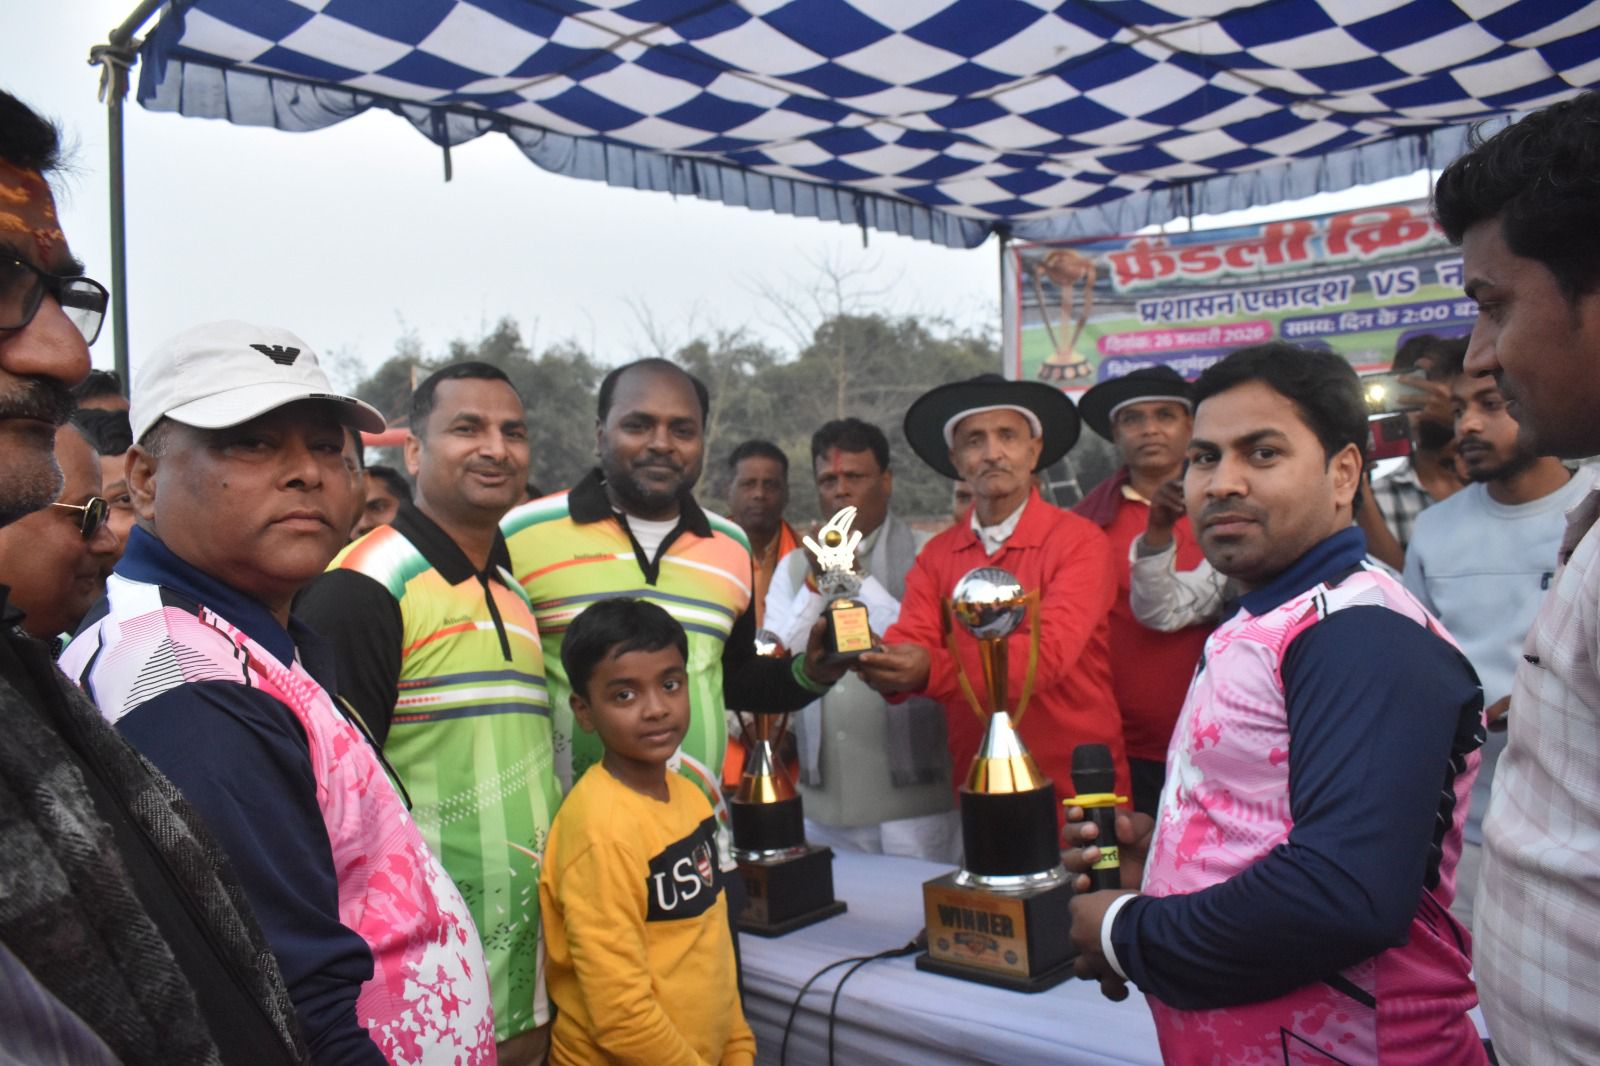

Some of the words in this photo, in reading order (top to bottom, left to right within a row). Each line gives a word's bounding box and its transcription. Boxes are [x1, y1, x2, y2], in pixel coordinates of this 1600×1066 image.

[1327, 206, 1446, 255] क्रि
[1139, 292, 1235, 322] प्रशासन
[1241, 280, 1351, 312] एकादश
[1373, 271, 1416, 297] VS
[1440, 263, 1465, 286] न
[1401, 305, 1450, 324] 2:00
[938, 903, 1015, 939] WINNER
